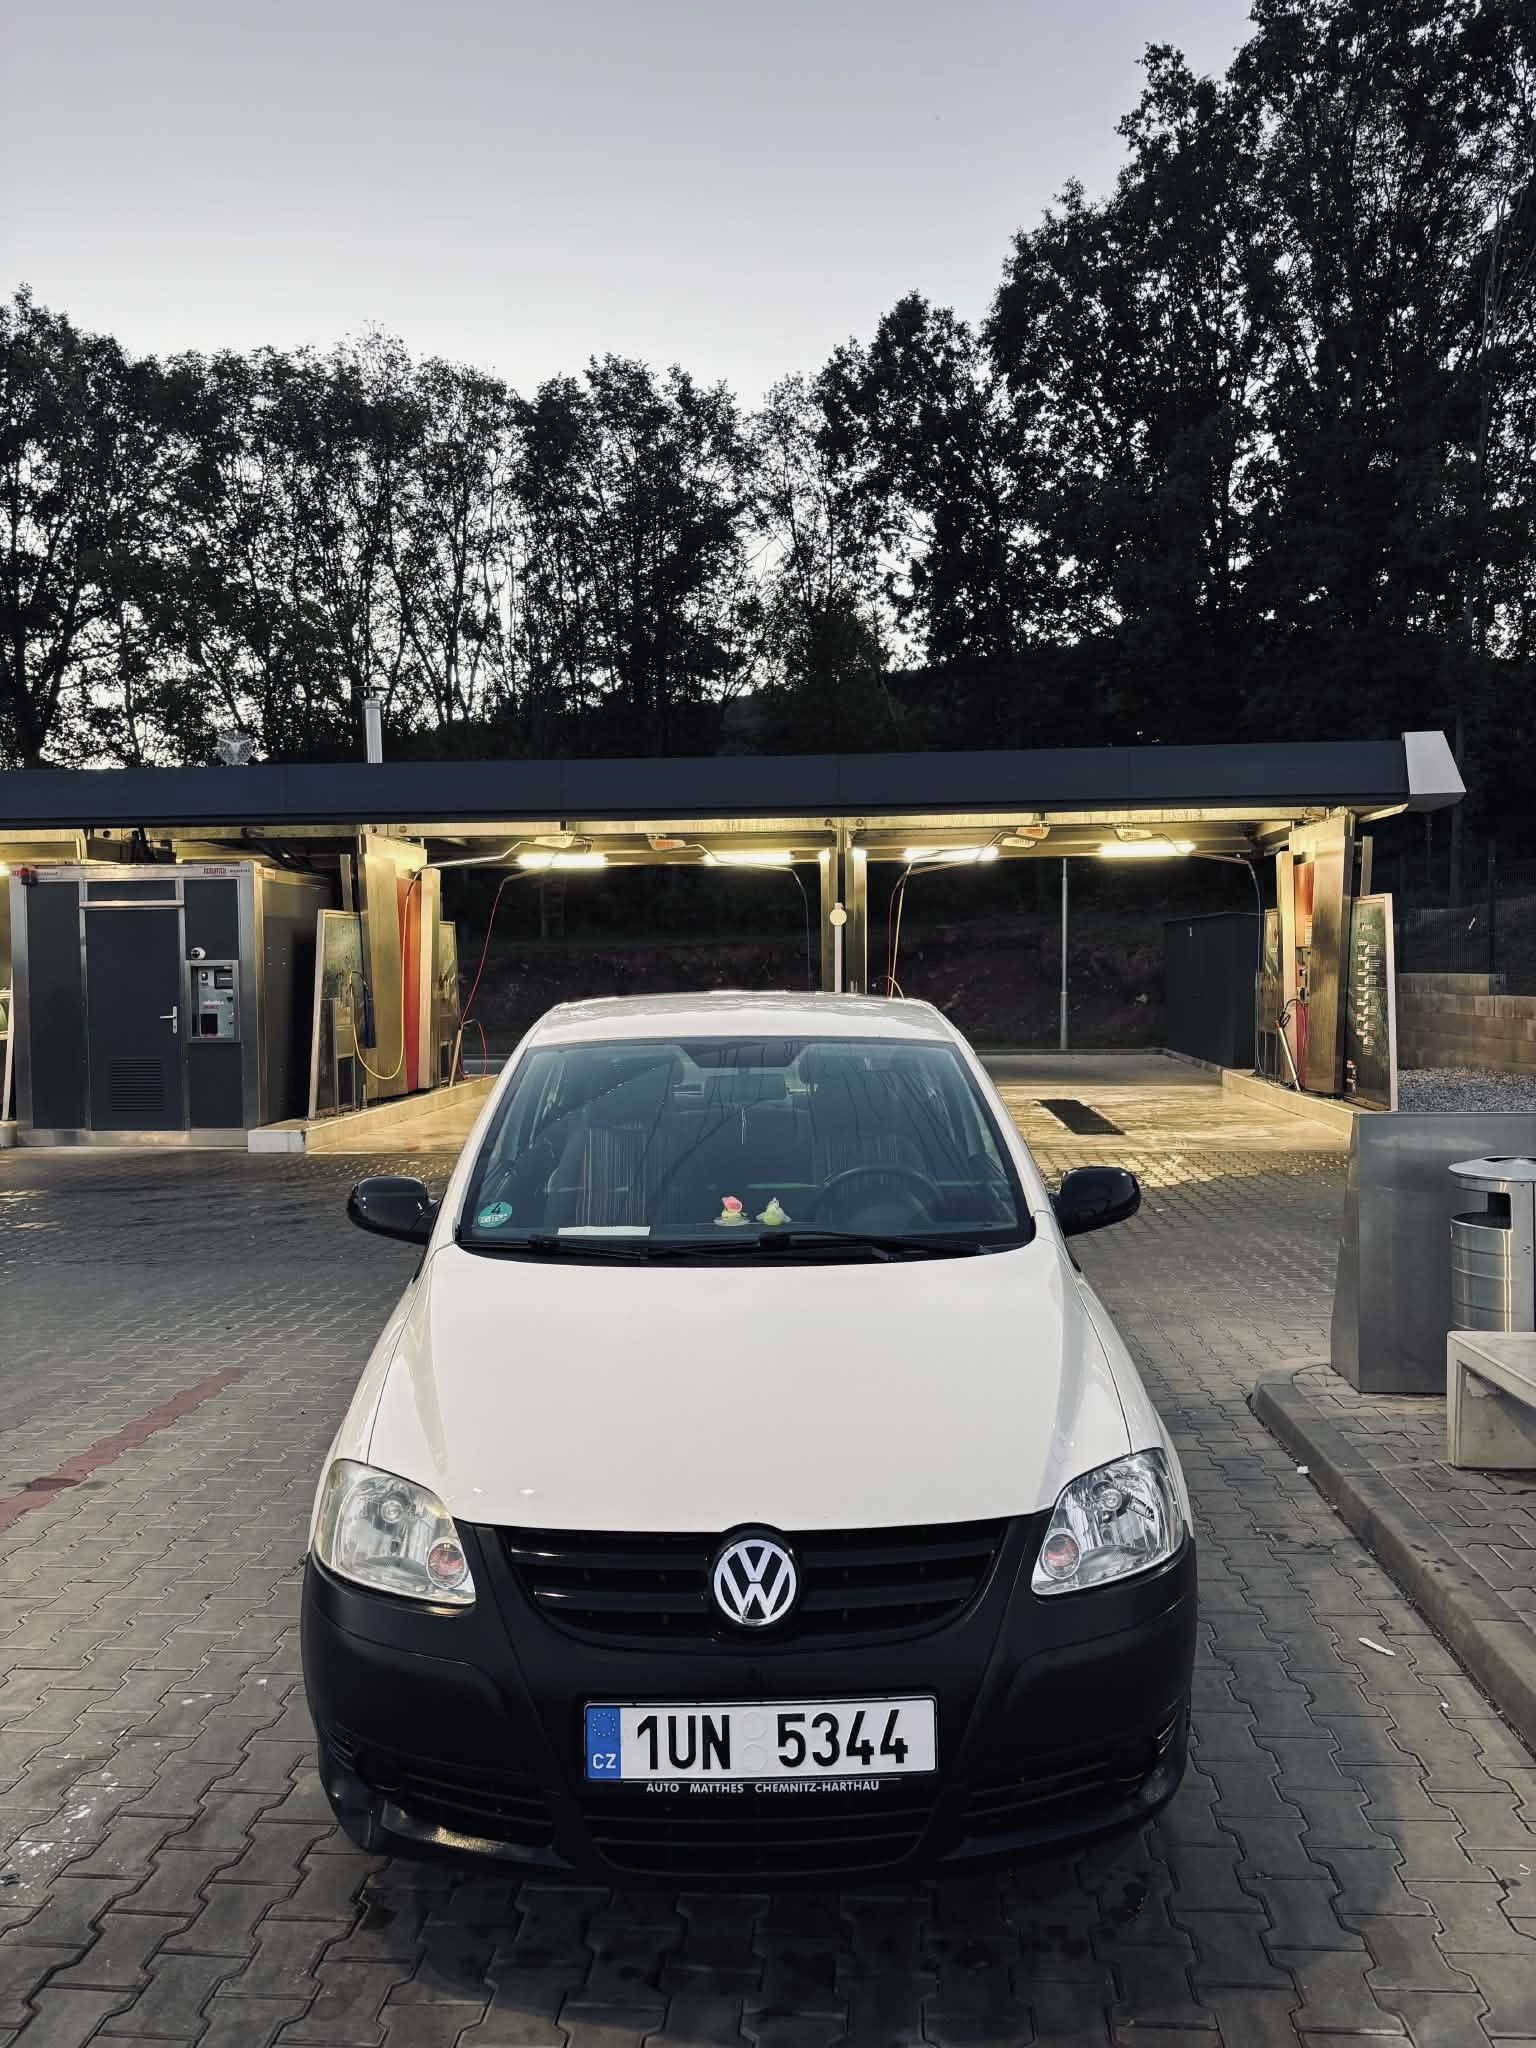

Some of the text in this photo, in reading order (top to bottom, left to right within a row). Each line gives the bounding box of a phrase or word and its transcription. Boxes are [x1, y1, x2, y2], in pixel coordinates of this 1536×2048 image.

[636, 1708, 910, 1770] 1UN 5344
[592, 1753, 617, 1769] CZ
[646, 1780, 880, 1793] AUTO MATTHES CHEMNITZ-HARTHAU
